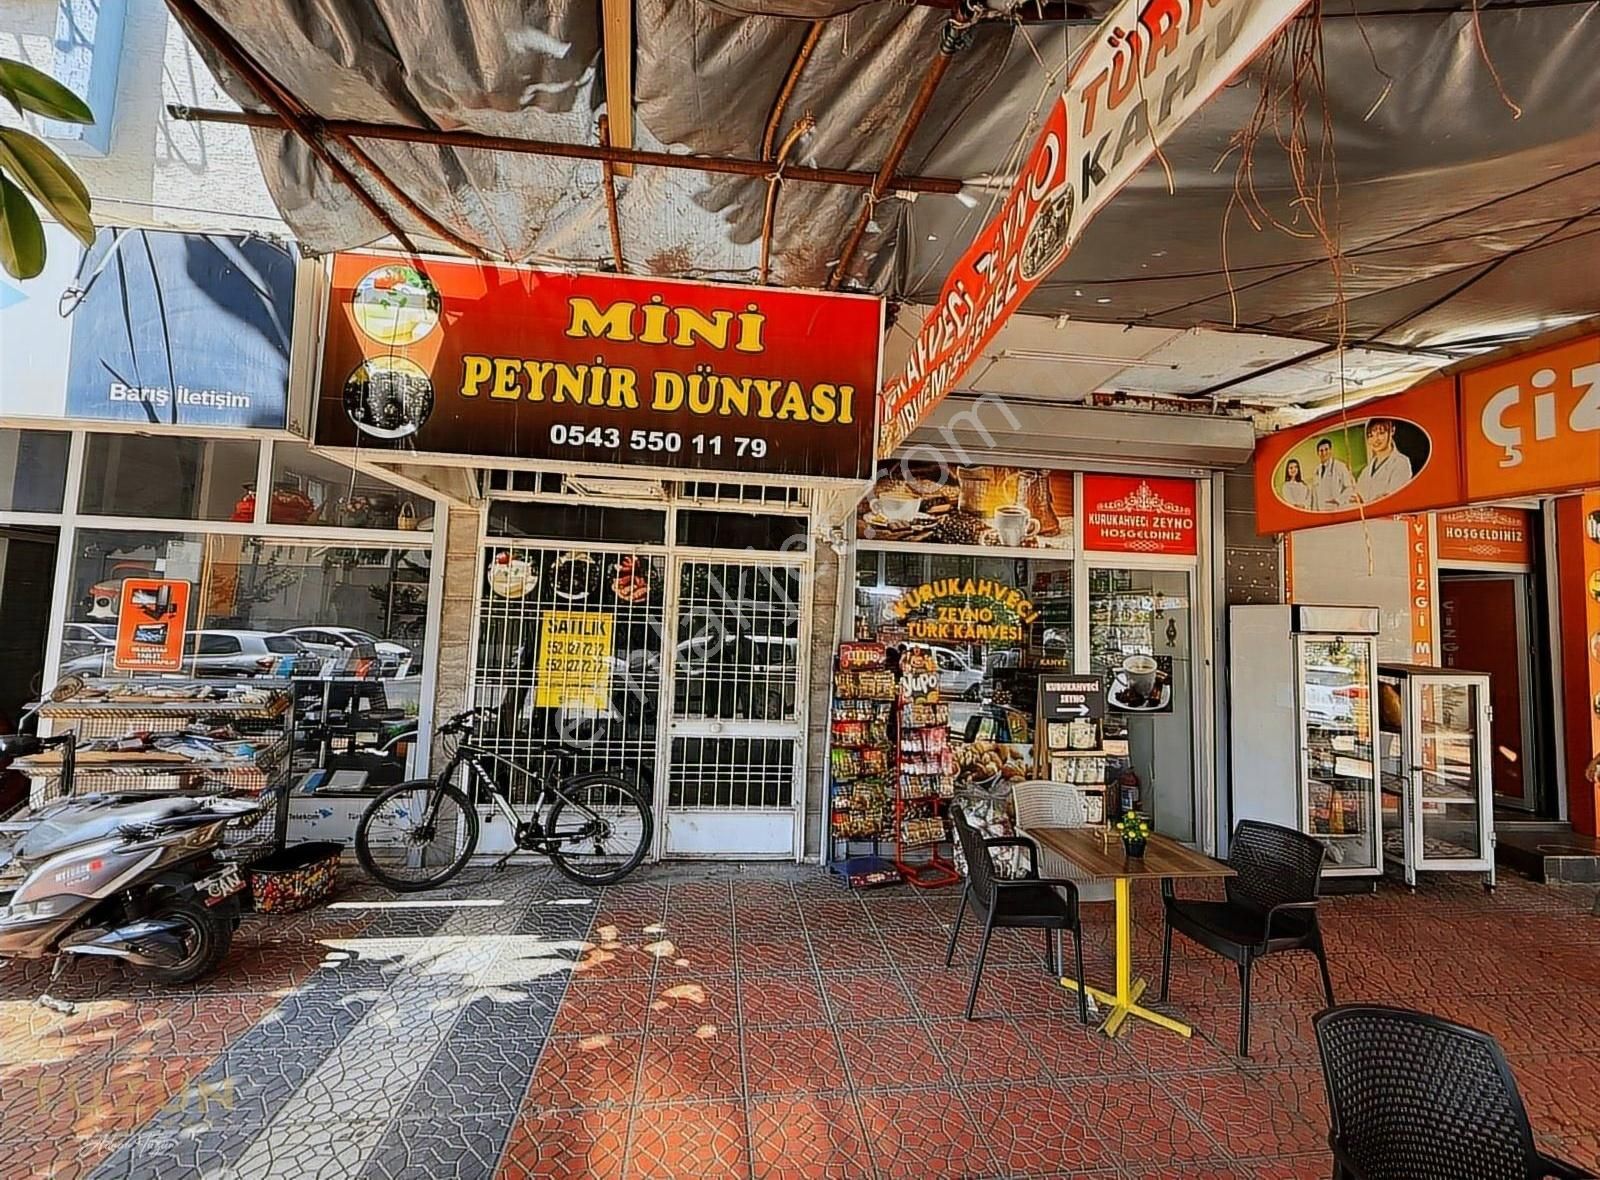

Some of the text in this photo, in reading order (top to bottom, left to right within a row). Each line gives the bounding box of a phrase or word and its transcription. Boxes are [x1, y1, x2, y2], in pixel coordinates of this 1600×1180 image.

[566, 295, 765, 352] MİNİ
[109, 383, 251, 410] Barış İletişim
[460, 356, 855, 424] PEYNİR DÜNYASI
[550, 424, 767, 458] 0543 550 11 79
[1152, 517, 1193, 530] ZEYNO
[893, 577, 1041, 624] KURUKAHVECİ
[547, 619, 606, 636] SATILIK
[938, 606, 993, 623] ZEYNO
[906, 619, 1022, 641] TÜRK KAHVESİ
